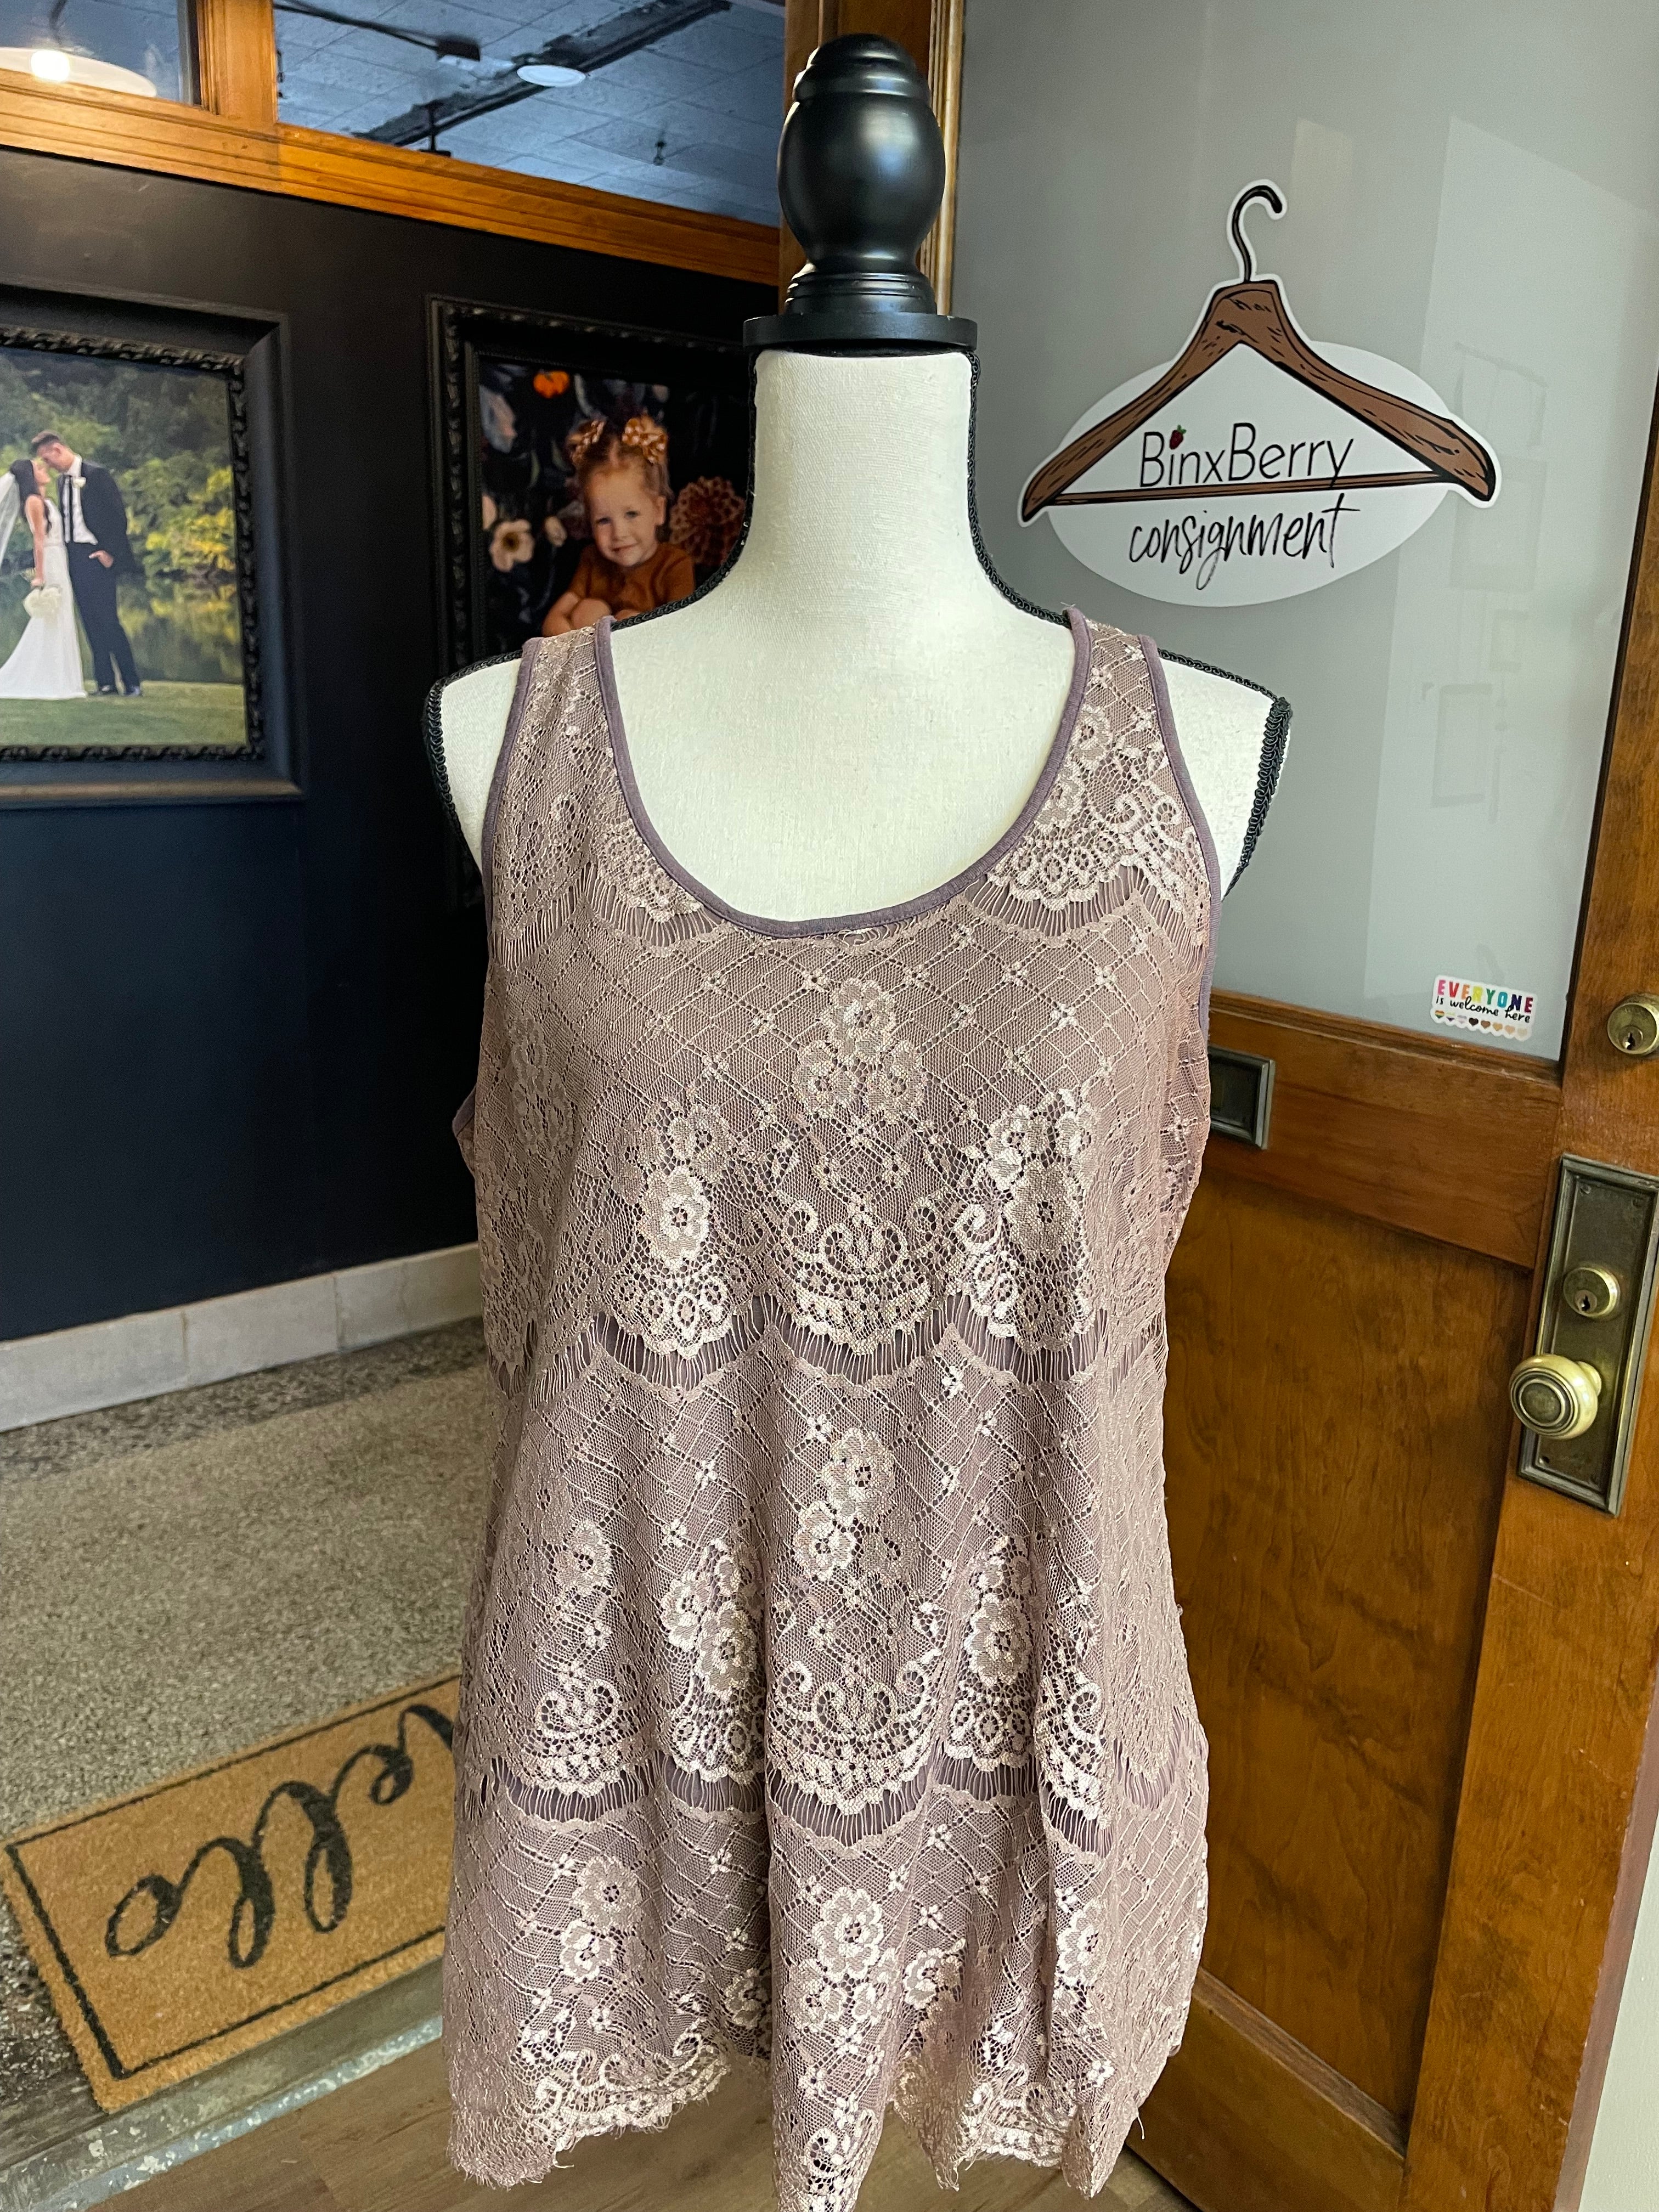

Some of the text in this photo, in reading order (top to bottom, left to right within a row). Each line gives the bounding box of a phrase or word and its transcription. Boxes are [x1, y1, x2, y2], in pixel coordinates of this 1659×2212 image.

[1139, 422, 1354, 488] BinxBerry
[1128, 493, 1361, 590] consignment
[1436, 996, 1531, 1024] is welcome here
[1437, 979, 1534, 1013] EVERYONE
[104, 1703, 454, 1969] ello
